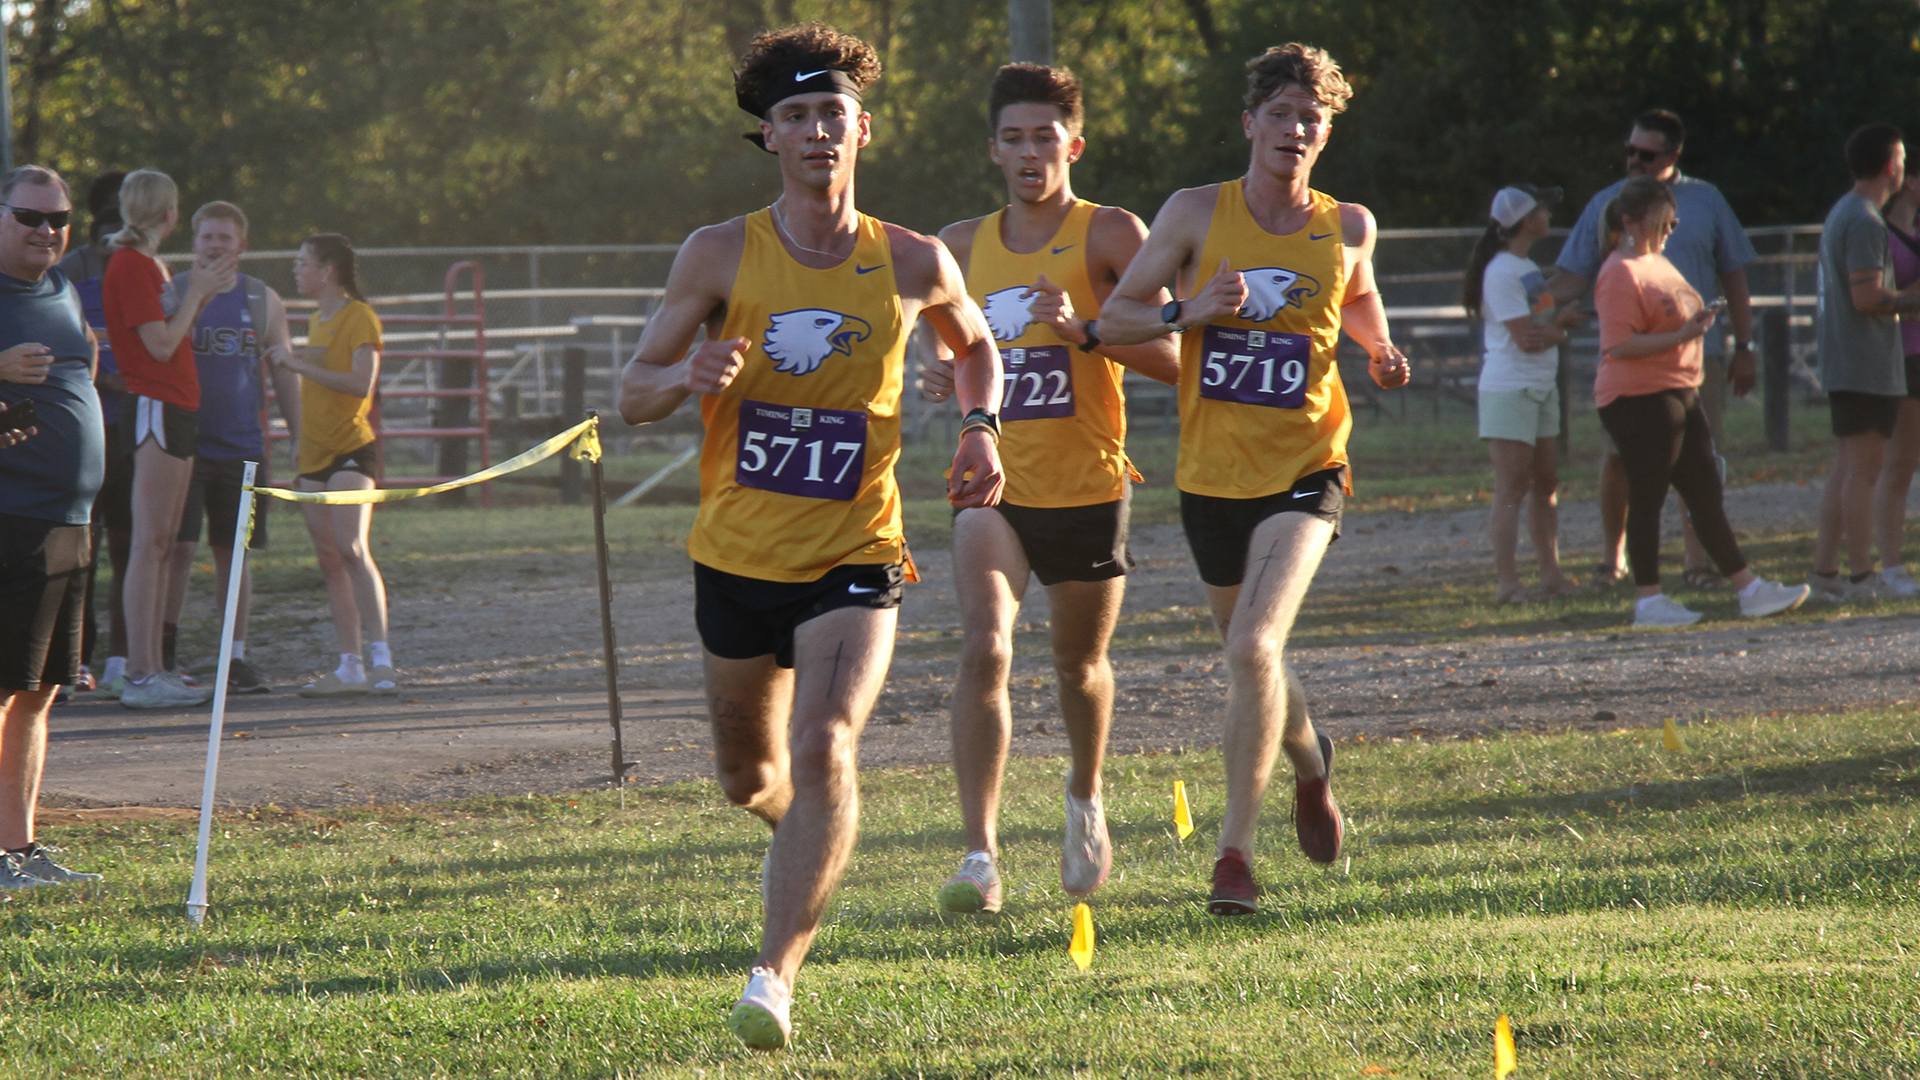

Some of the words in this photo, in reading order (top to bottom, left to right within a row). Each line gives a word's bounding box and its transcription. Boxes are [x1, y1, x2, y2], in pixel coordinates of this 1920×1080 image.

[192, 327, 257, 356] USA
[1218, 331, 1247, 341] TIMING
[1271, 337, 1293, 345] KING
[1002, 370, 1071, 408] 722
[1202, 351, 1306, 394] 5719
[755, 408, 790, 420] TIMING
[819, 415, 845, 425] KING
[740, 431, 862, 484] 5717
